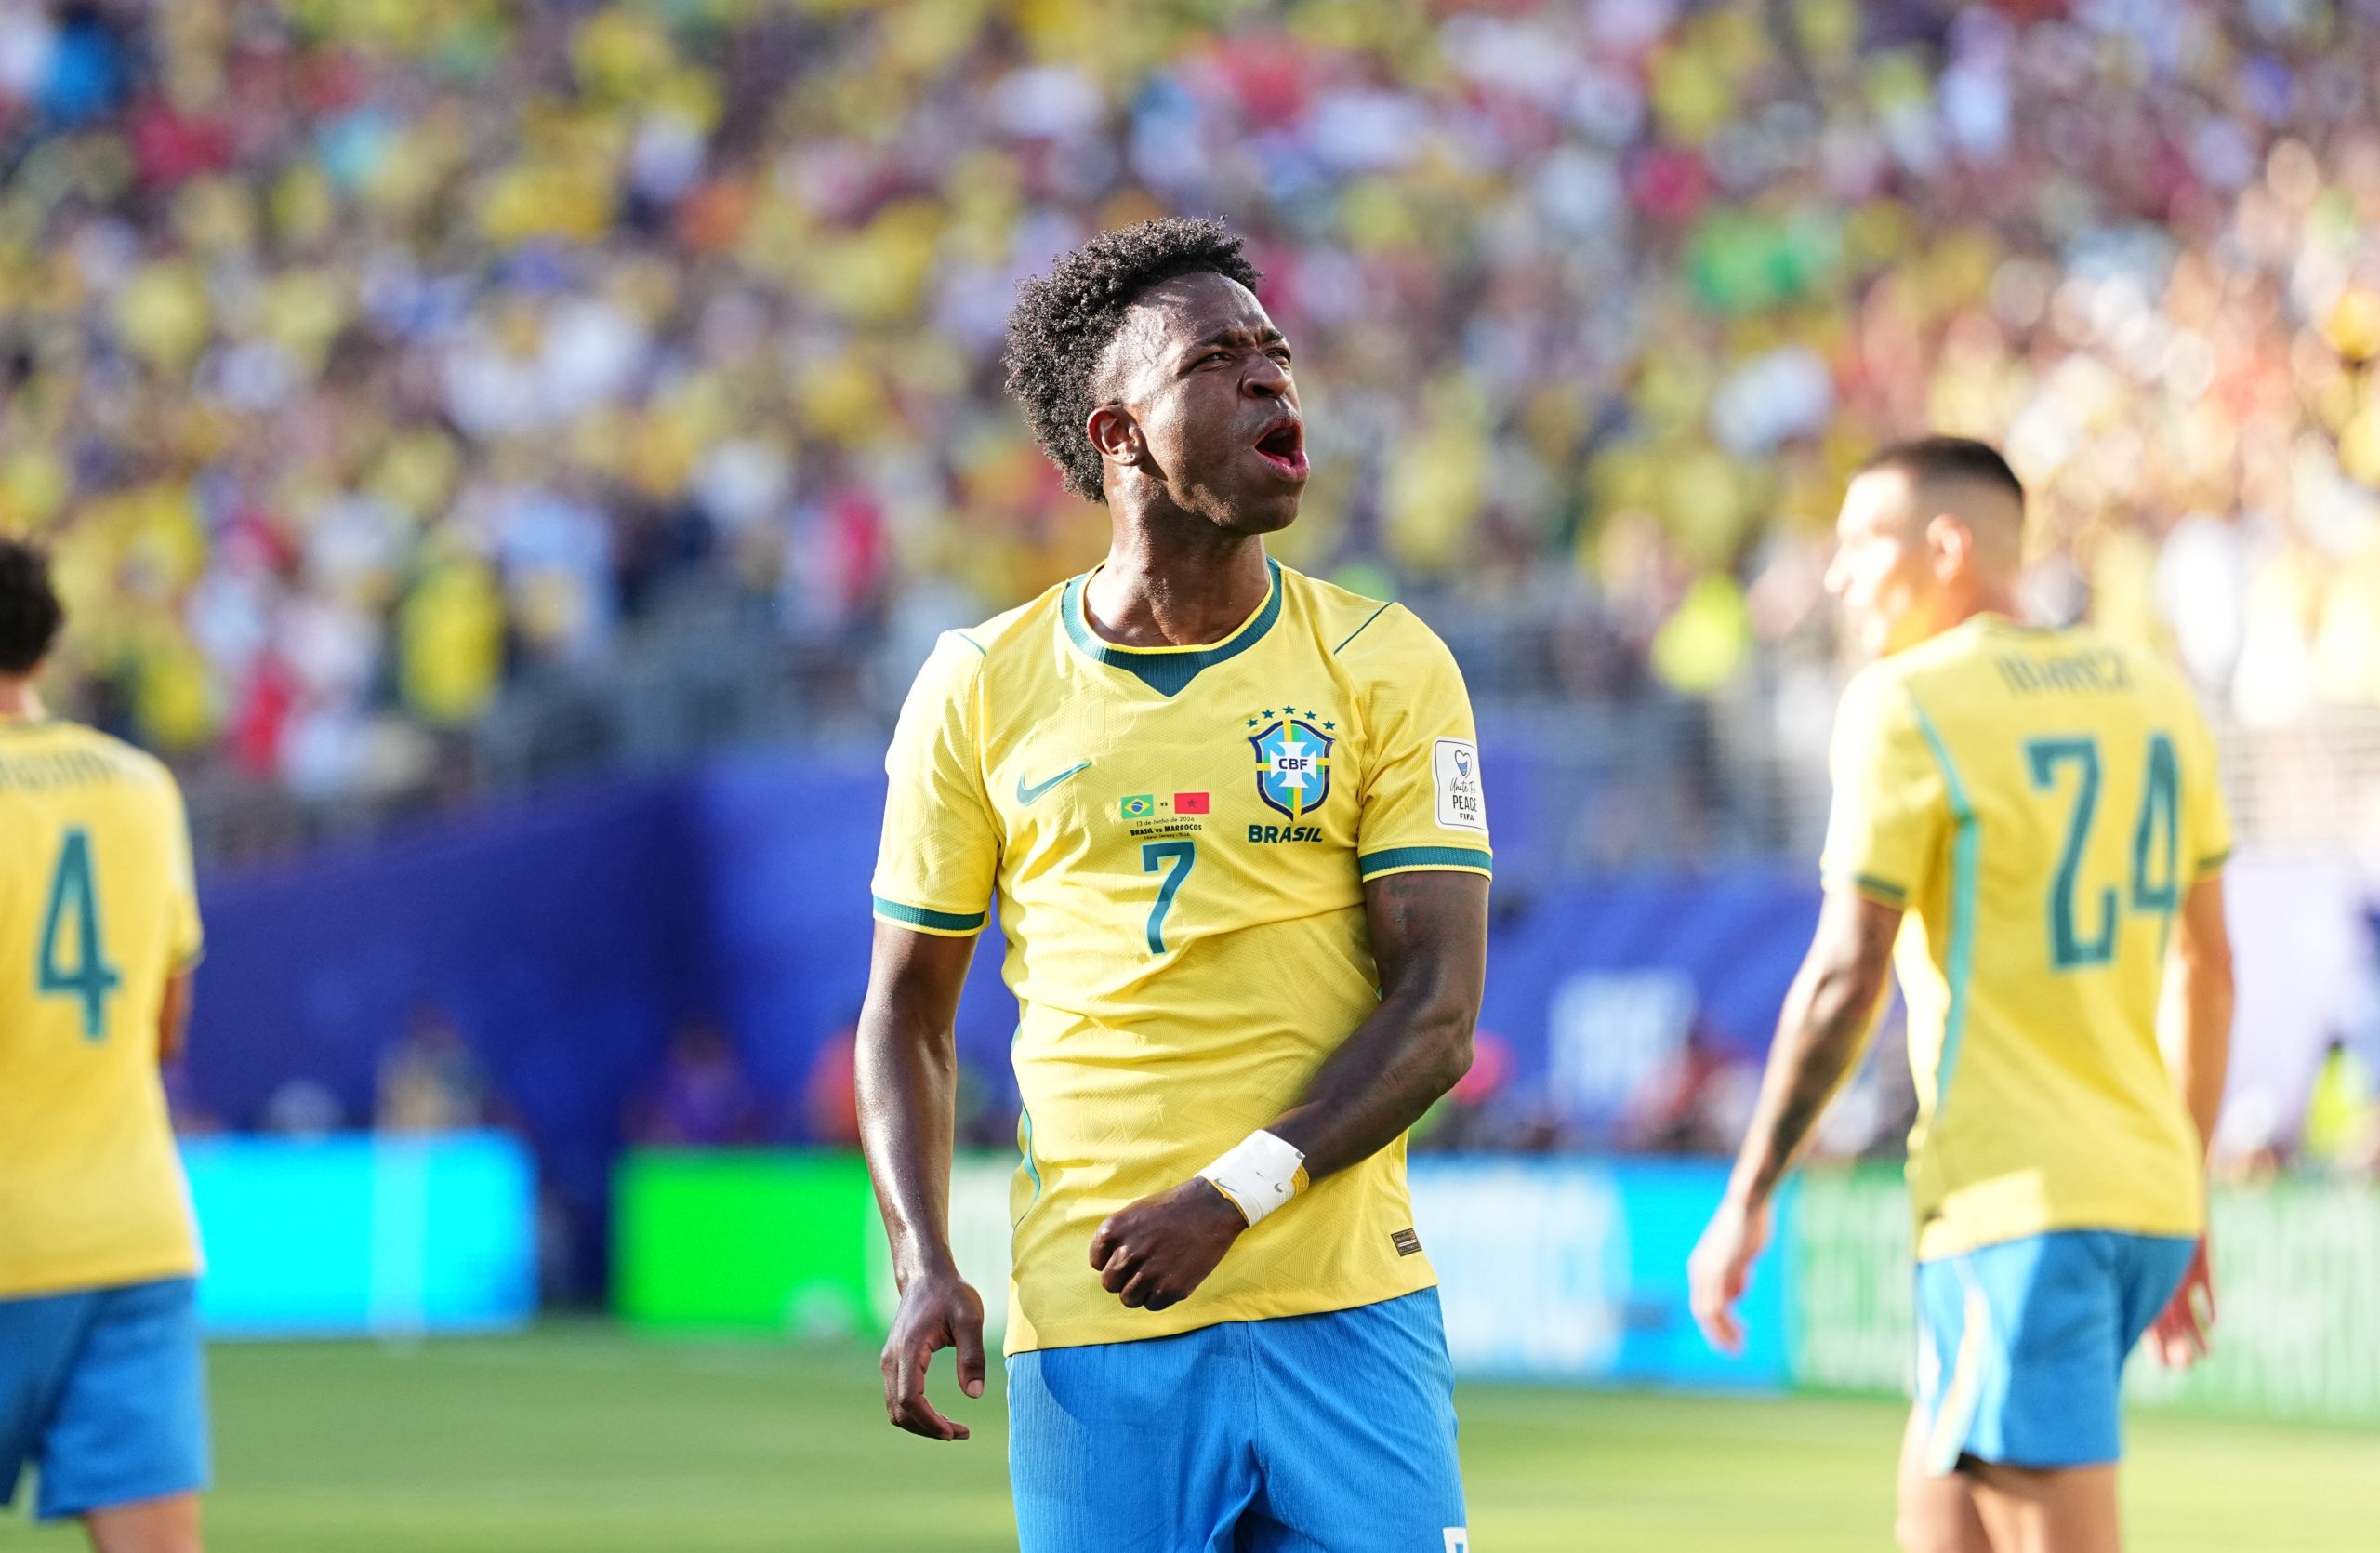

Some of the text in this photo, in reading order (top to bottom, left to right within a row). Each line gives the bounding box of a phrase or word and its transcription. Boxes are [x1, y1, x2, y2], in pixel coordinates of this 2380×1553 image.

[1278, 758, 1308, 770] CBF
[1452, 795, 1477, 812] PEACE
[1460, 813, 1474, 821] FIFA
[1130, 828, 1154, 836] BRASIL
[1165, 824, 1202, 832] MARROCOS
[1248, 824, 1323, 843] BRASIL
[2024, 730, 2180, 969] 24
[1142, 841, 1196, 955] 7
[36, 825, 119, 1040] 4
